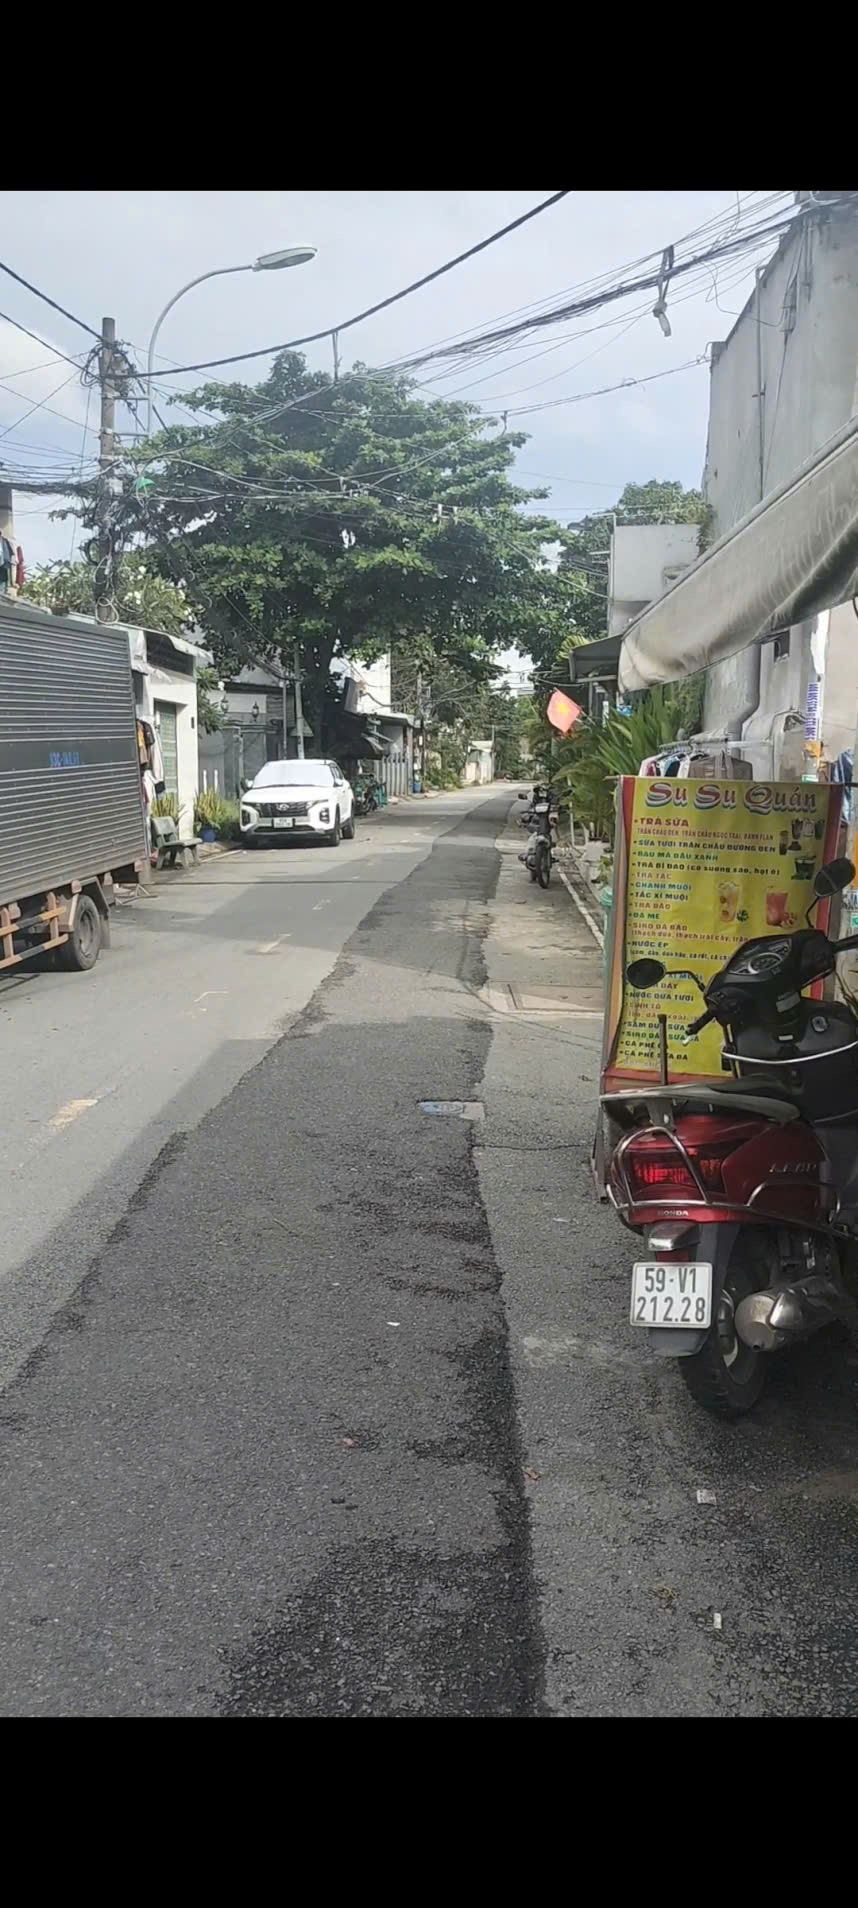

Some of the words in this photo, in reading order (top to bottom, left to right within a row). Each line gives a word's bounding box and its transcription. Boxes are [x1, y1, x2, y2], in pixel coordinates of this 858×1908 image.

[646, 782, 688, 808] Su
[694, 784, 736, 809] Su
[744, 784, 816, 815] Quán
[635, 881, 666, 890] CHANH
[657, 1209, 689, 1218] HONDA
[644, 1267, 697, 1294] 59-V1
[635, 1297, 706, 1323] 212.28
